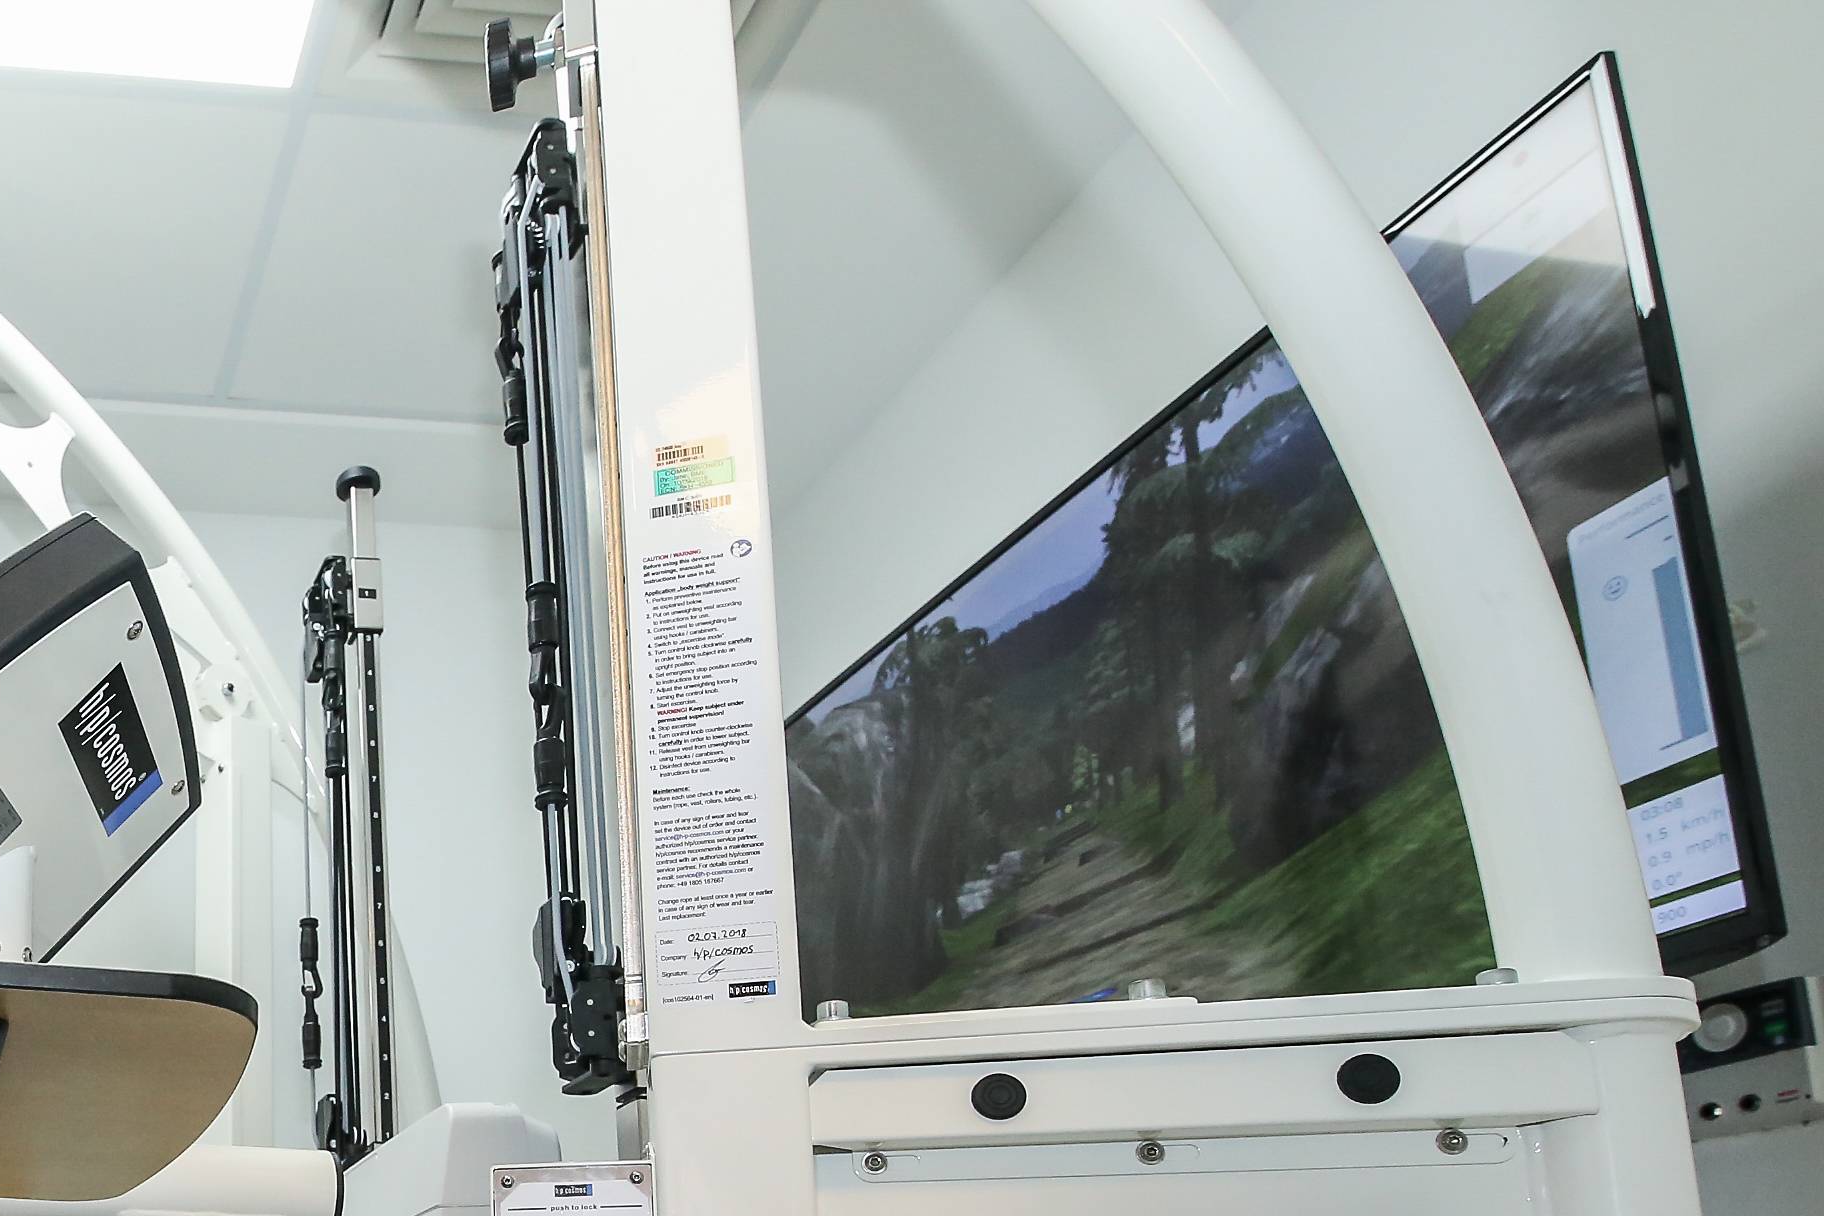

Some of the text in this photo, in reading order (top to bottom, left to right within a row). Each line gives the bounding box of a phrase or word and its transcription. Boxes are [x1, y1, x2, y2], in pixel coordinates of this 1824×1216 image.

[75, 682, 137, 801] h/p/cosmos
[693, 945, 754, 960] h/p/cosmos
[550, 1204, 569, 1212] push
[581, 1203, 598, 1211] lock
